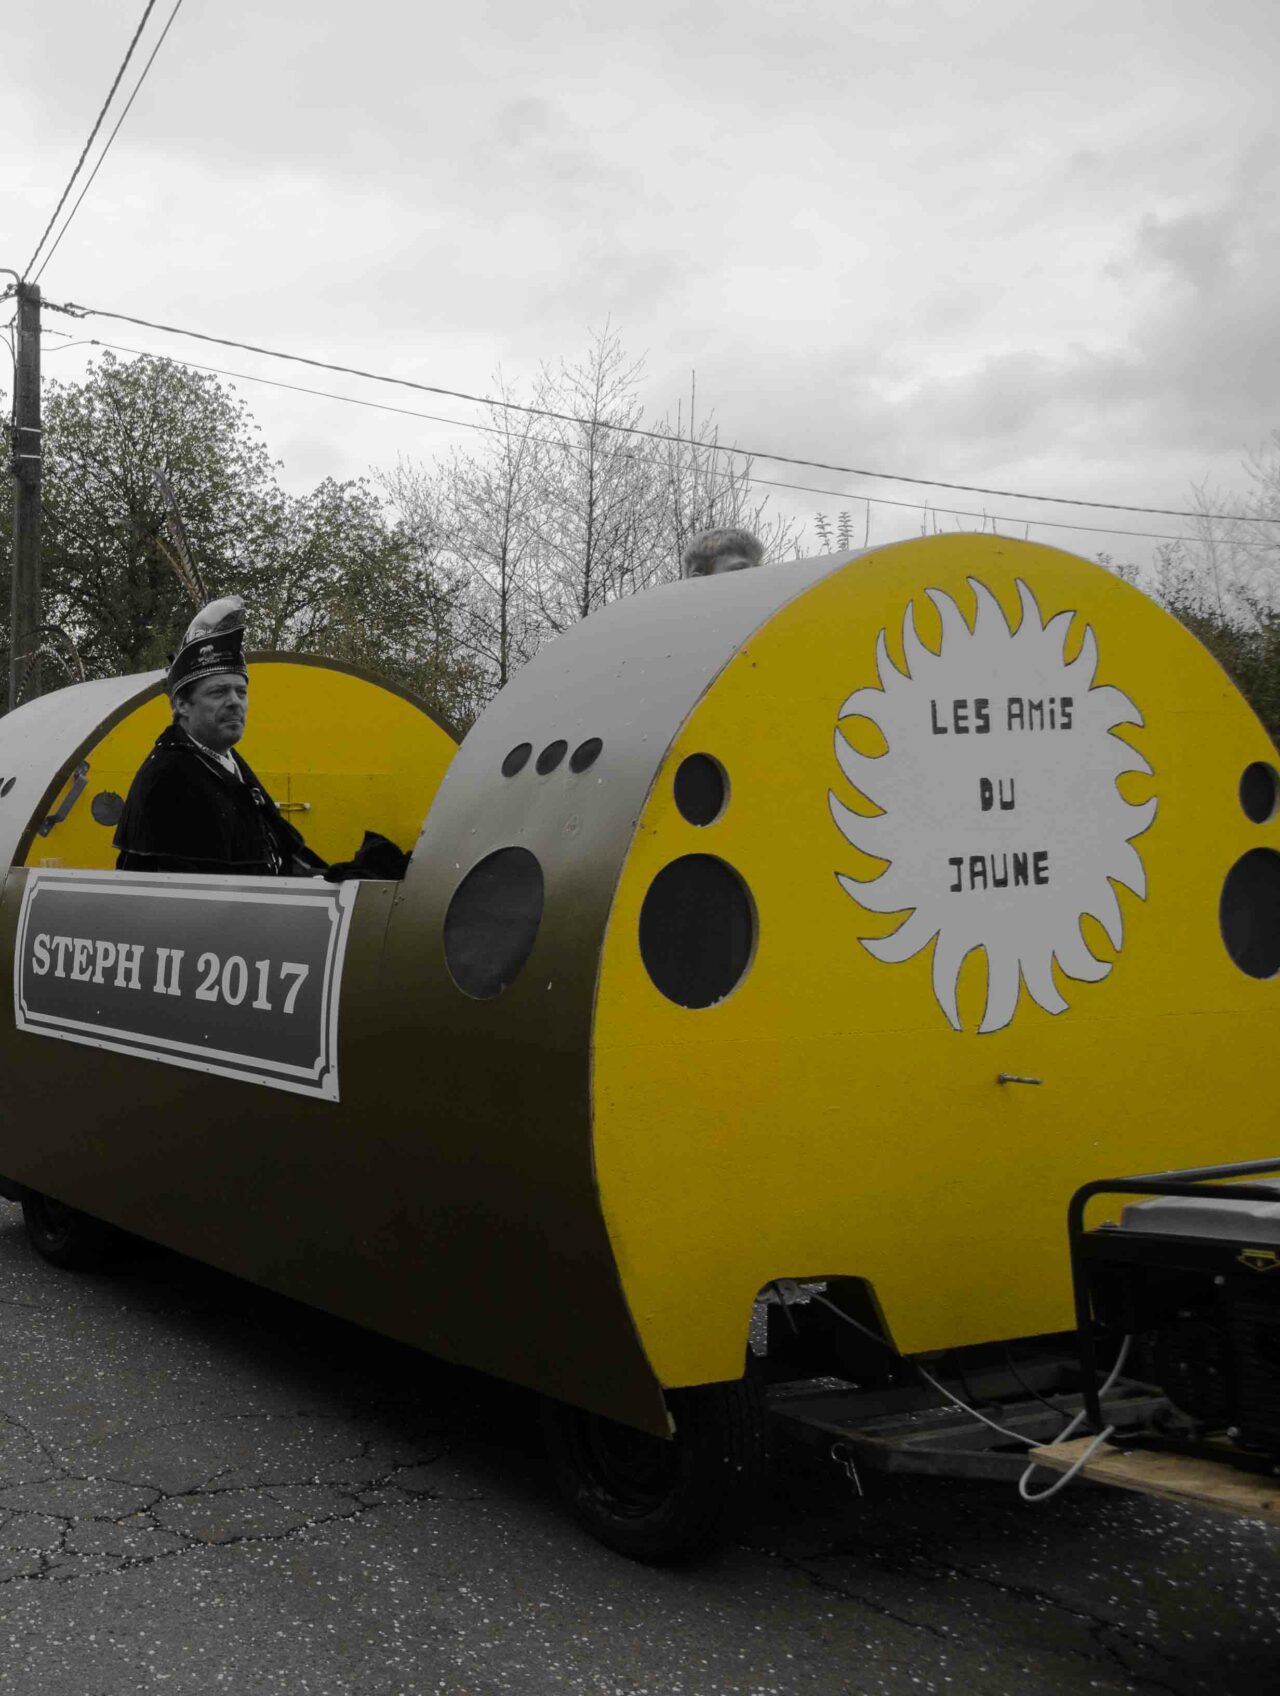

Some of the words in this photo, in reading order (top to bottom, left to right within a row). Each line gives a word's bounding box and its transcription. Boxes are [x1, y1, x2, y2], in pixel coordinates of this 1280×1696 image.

[930, 698, 990, 735] LES
[979, 777, 1015, 811] DU
[948, 850, 1049, 893] JAUNE
[32, 933, 145, 990] STEPH
[153, 947, 185, 997] II
[195, 952, 310, 1014] 2017
